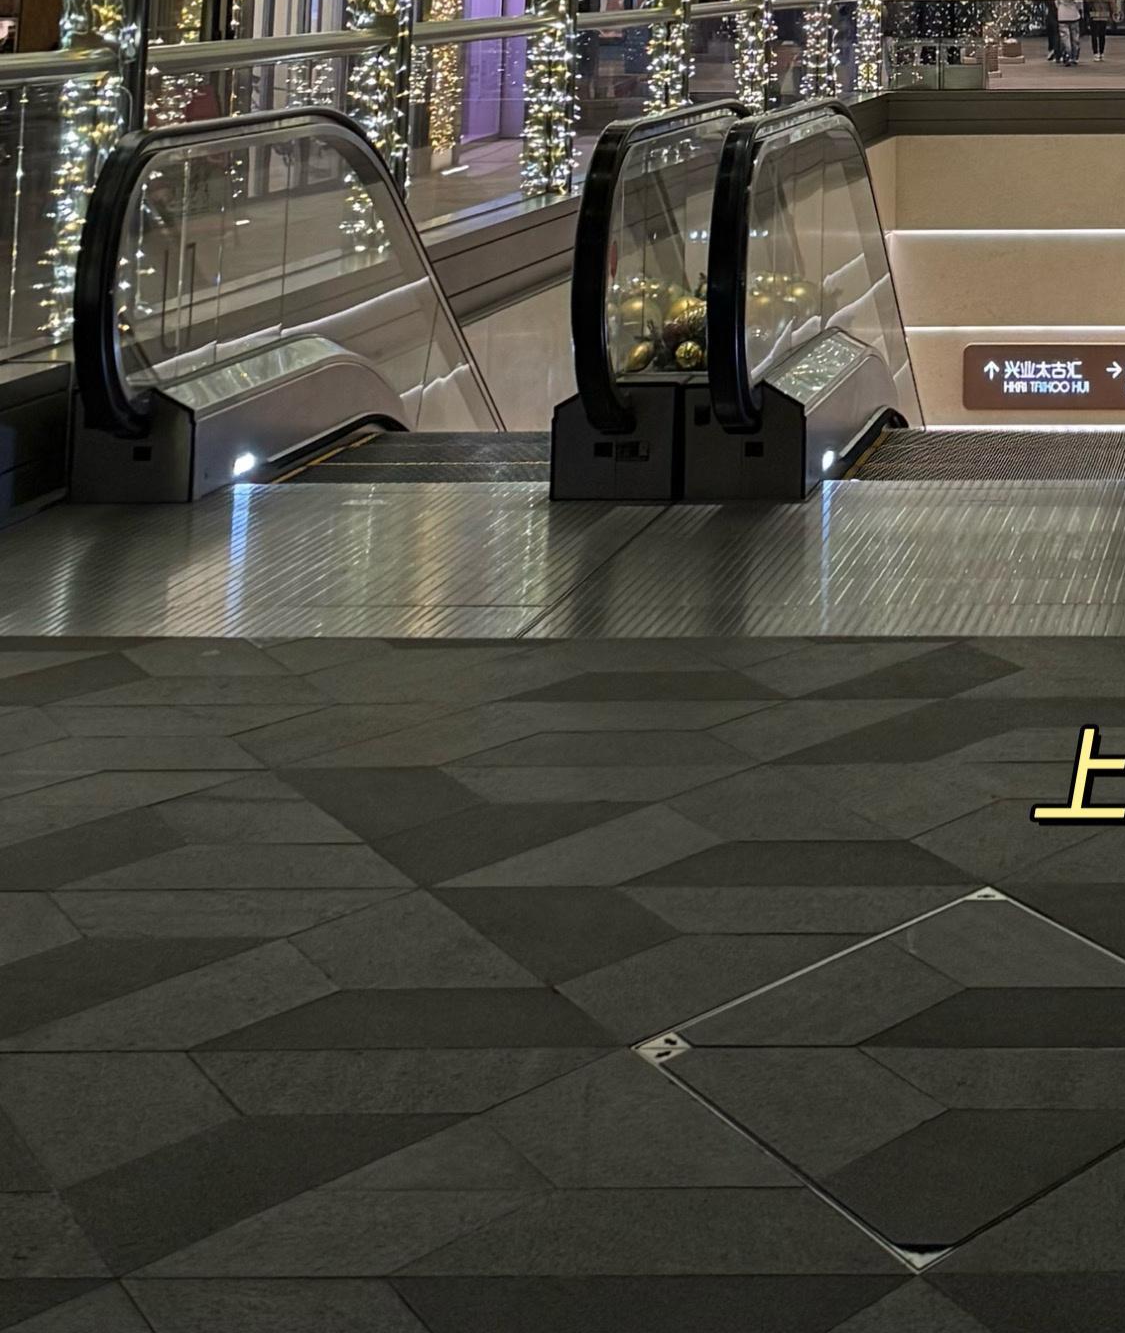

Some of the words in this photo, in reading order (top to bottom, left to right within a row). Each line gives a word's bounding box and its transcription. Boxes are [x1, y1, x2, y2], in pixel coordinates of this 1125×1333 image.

[1004, 360, 1083, 379] 兴业太古汇
[1071, 381, 1090, 393] HUI
